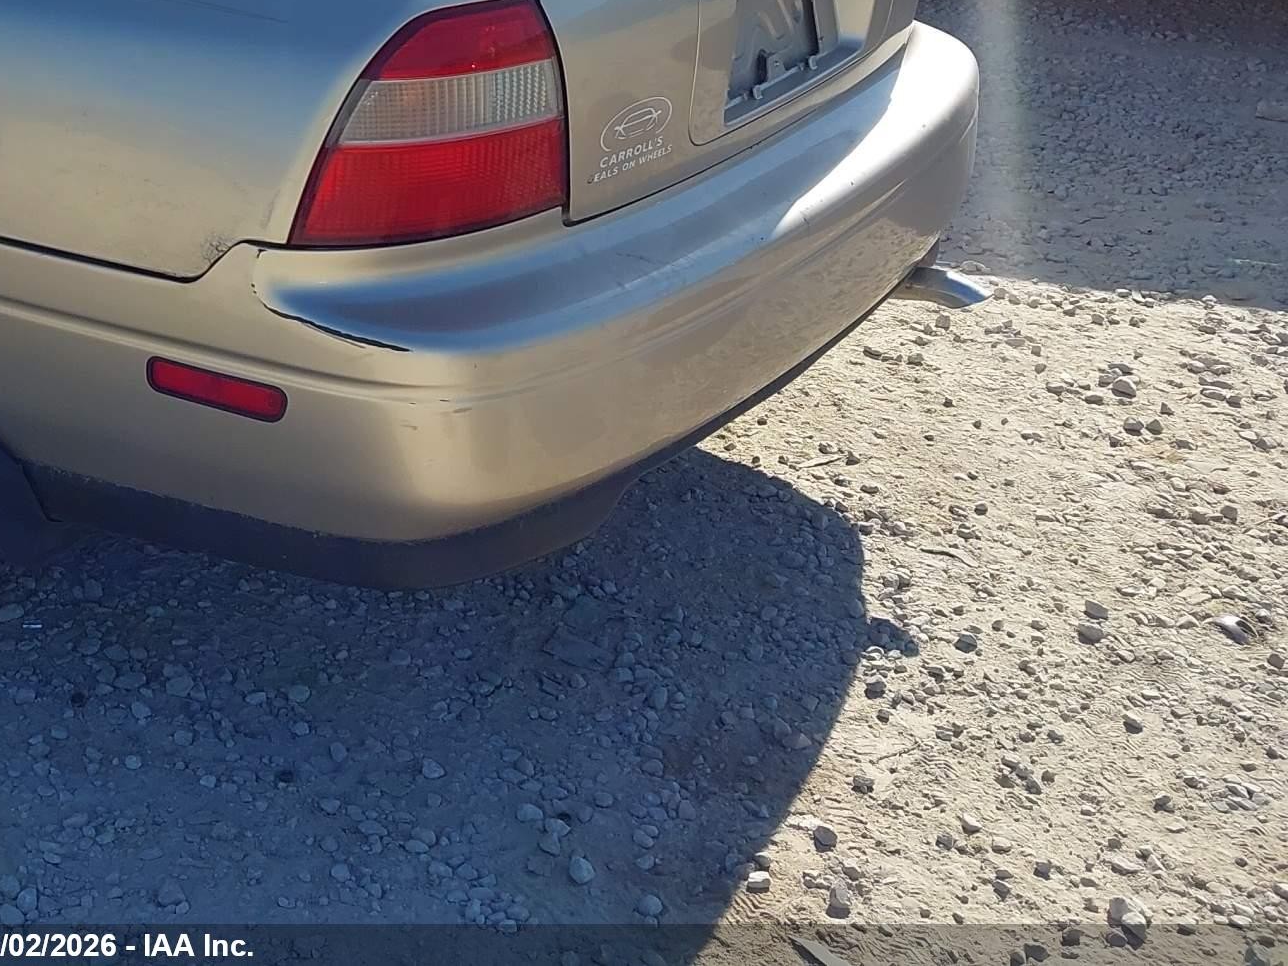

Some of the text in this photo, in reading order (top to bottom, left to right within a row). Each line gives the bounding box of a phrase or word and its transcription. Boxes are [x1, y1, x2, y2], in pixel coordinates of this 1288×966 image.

[588, 144, 673, 183] EALS ON WHEELS
[600, 135, 663, 168] CARROLL'S
